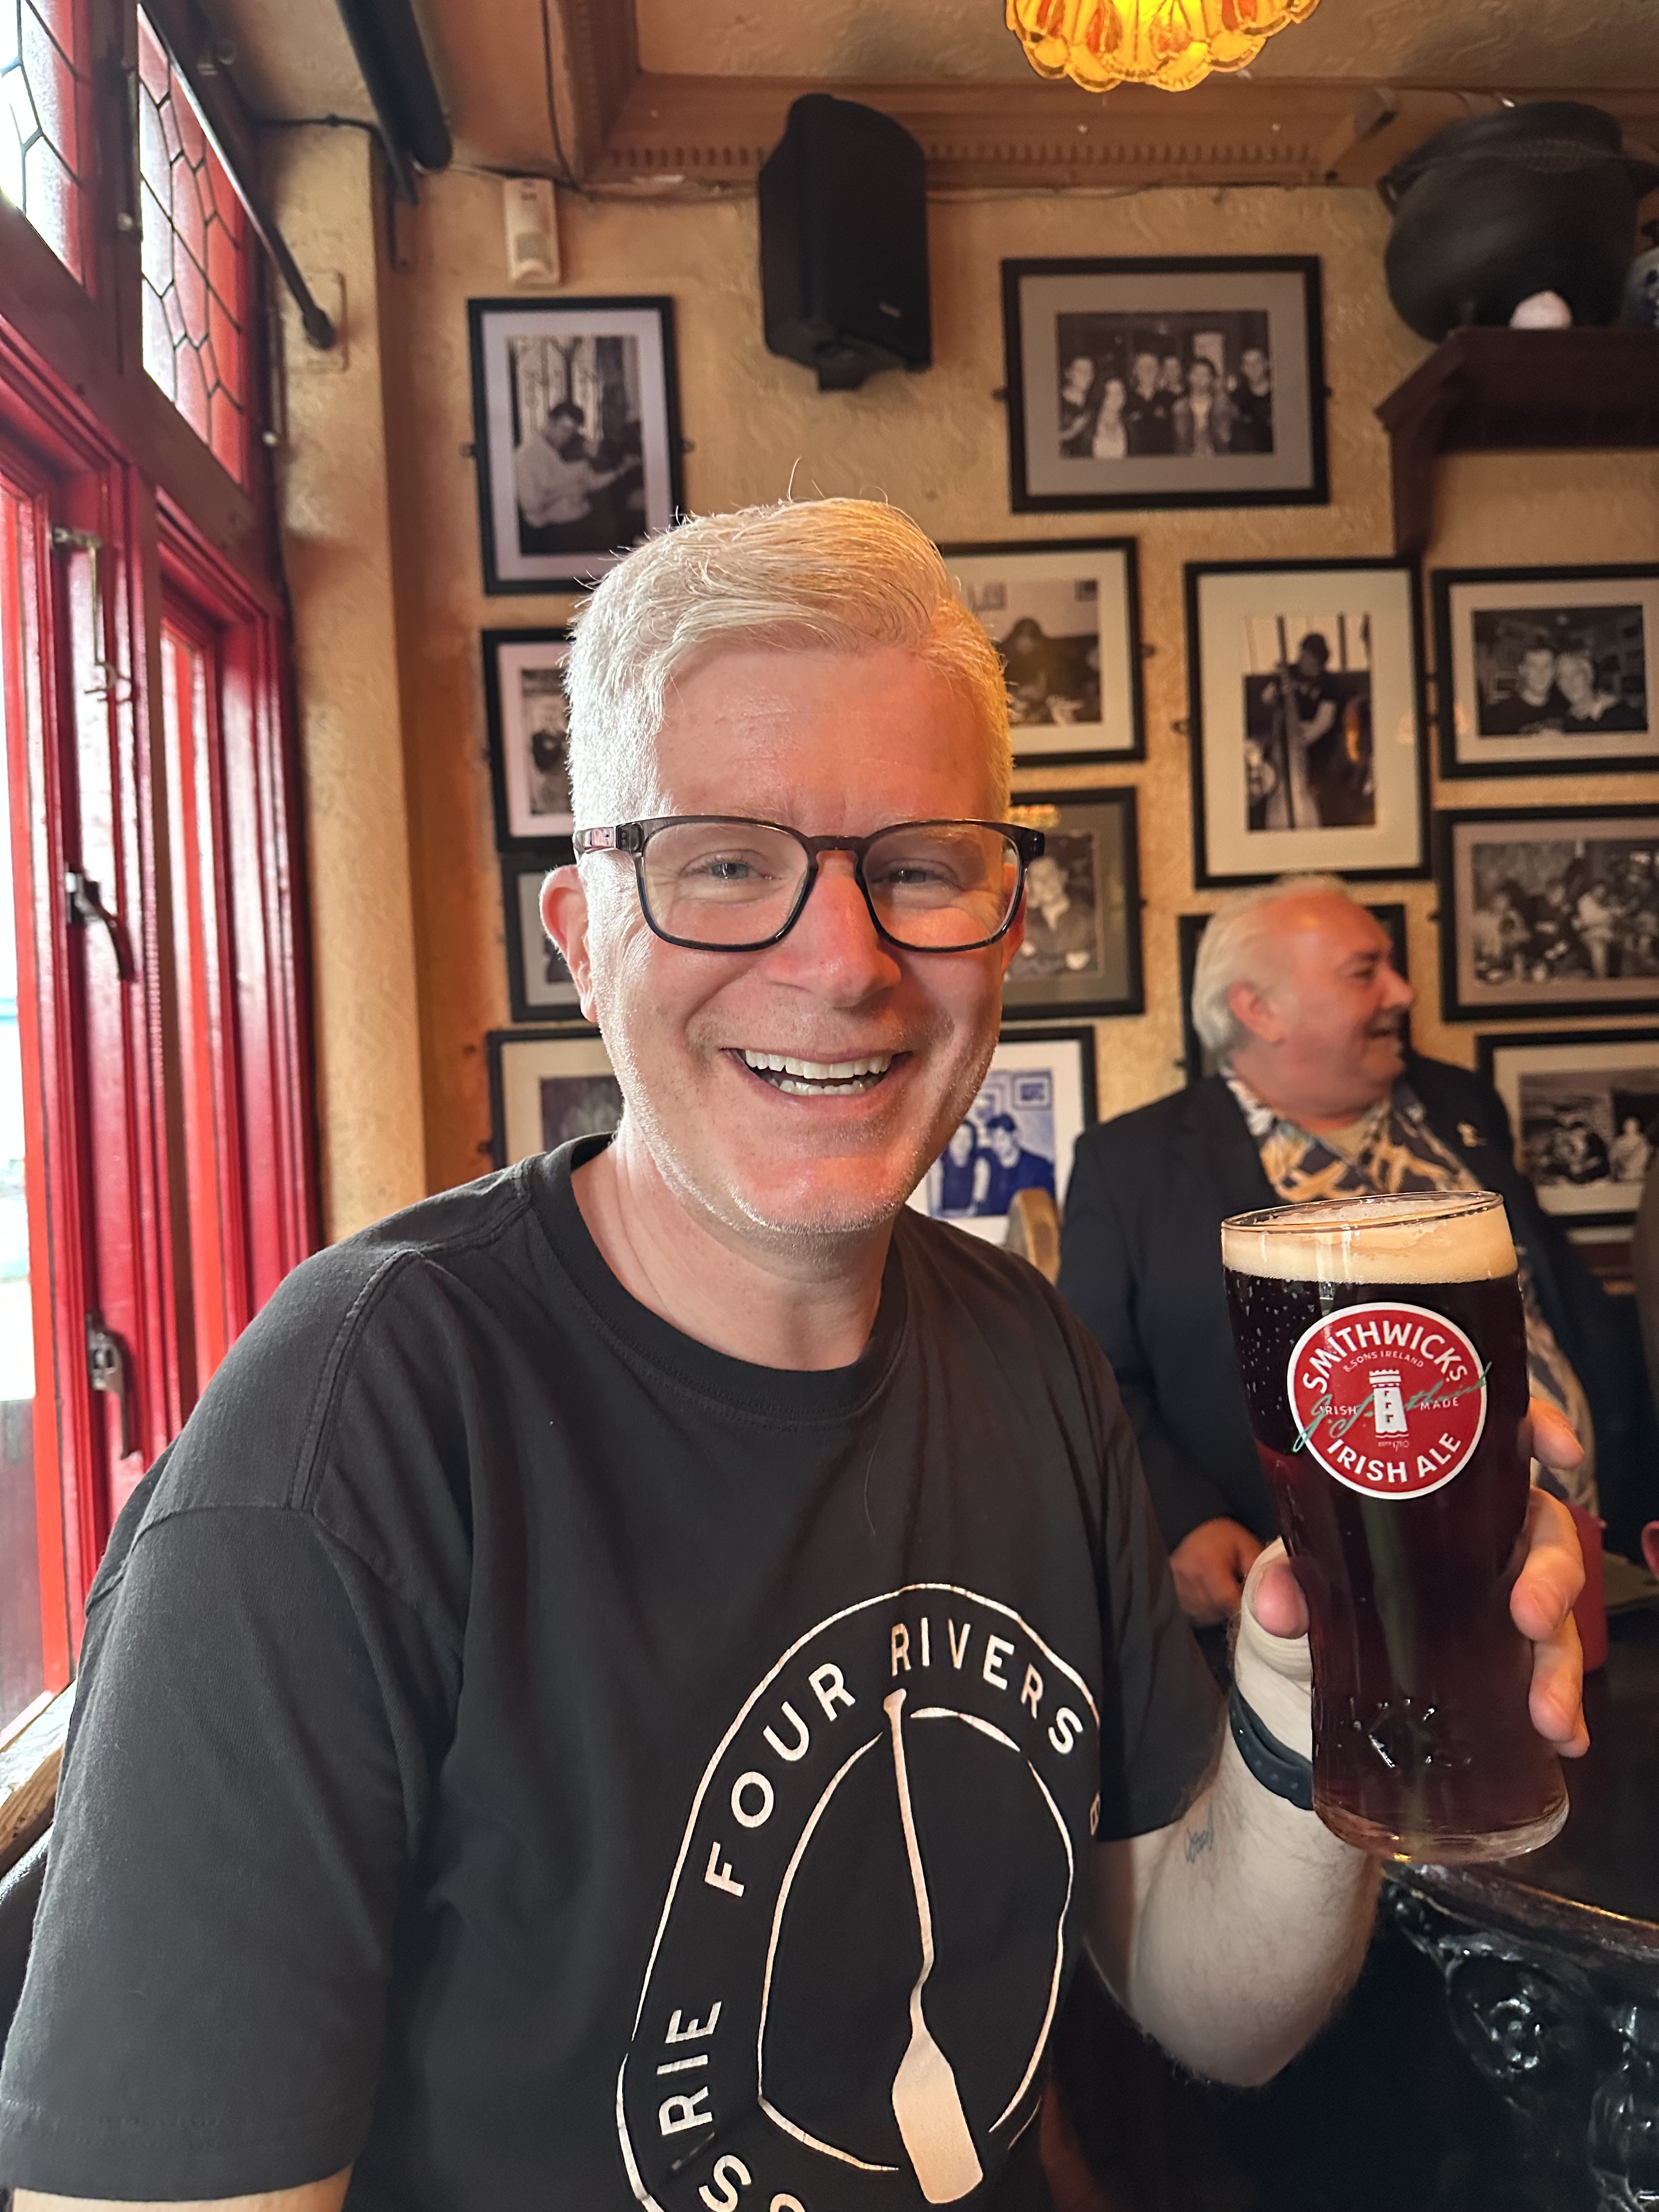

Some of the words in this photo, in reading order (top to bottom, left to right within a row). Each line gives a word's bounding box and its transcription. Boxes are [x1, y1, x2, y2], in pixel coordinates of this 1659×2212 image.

[1350, 1351, 1378, 1368] SONS
[1380, 1350, 1424, 1368] IRELAND
[1327, 1438, 1408, 1483] IRISH
[1416, 1432, 1462, 1478] ALE
[704, 1662, 856, 1897] FOUR
[891, 1617, 1084, 1755] RIVERS
